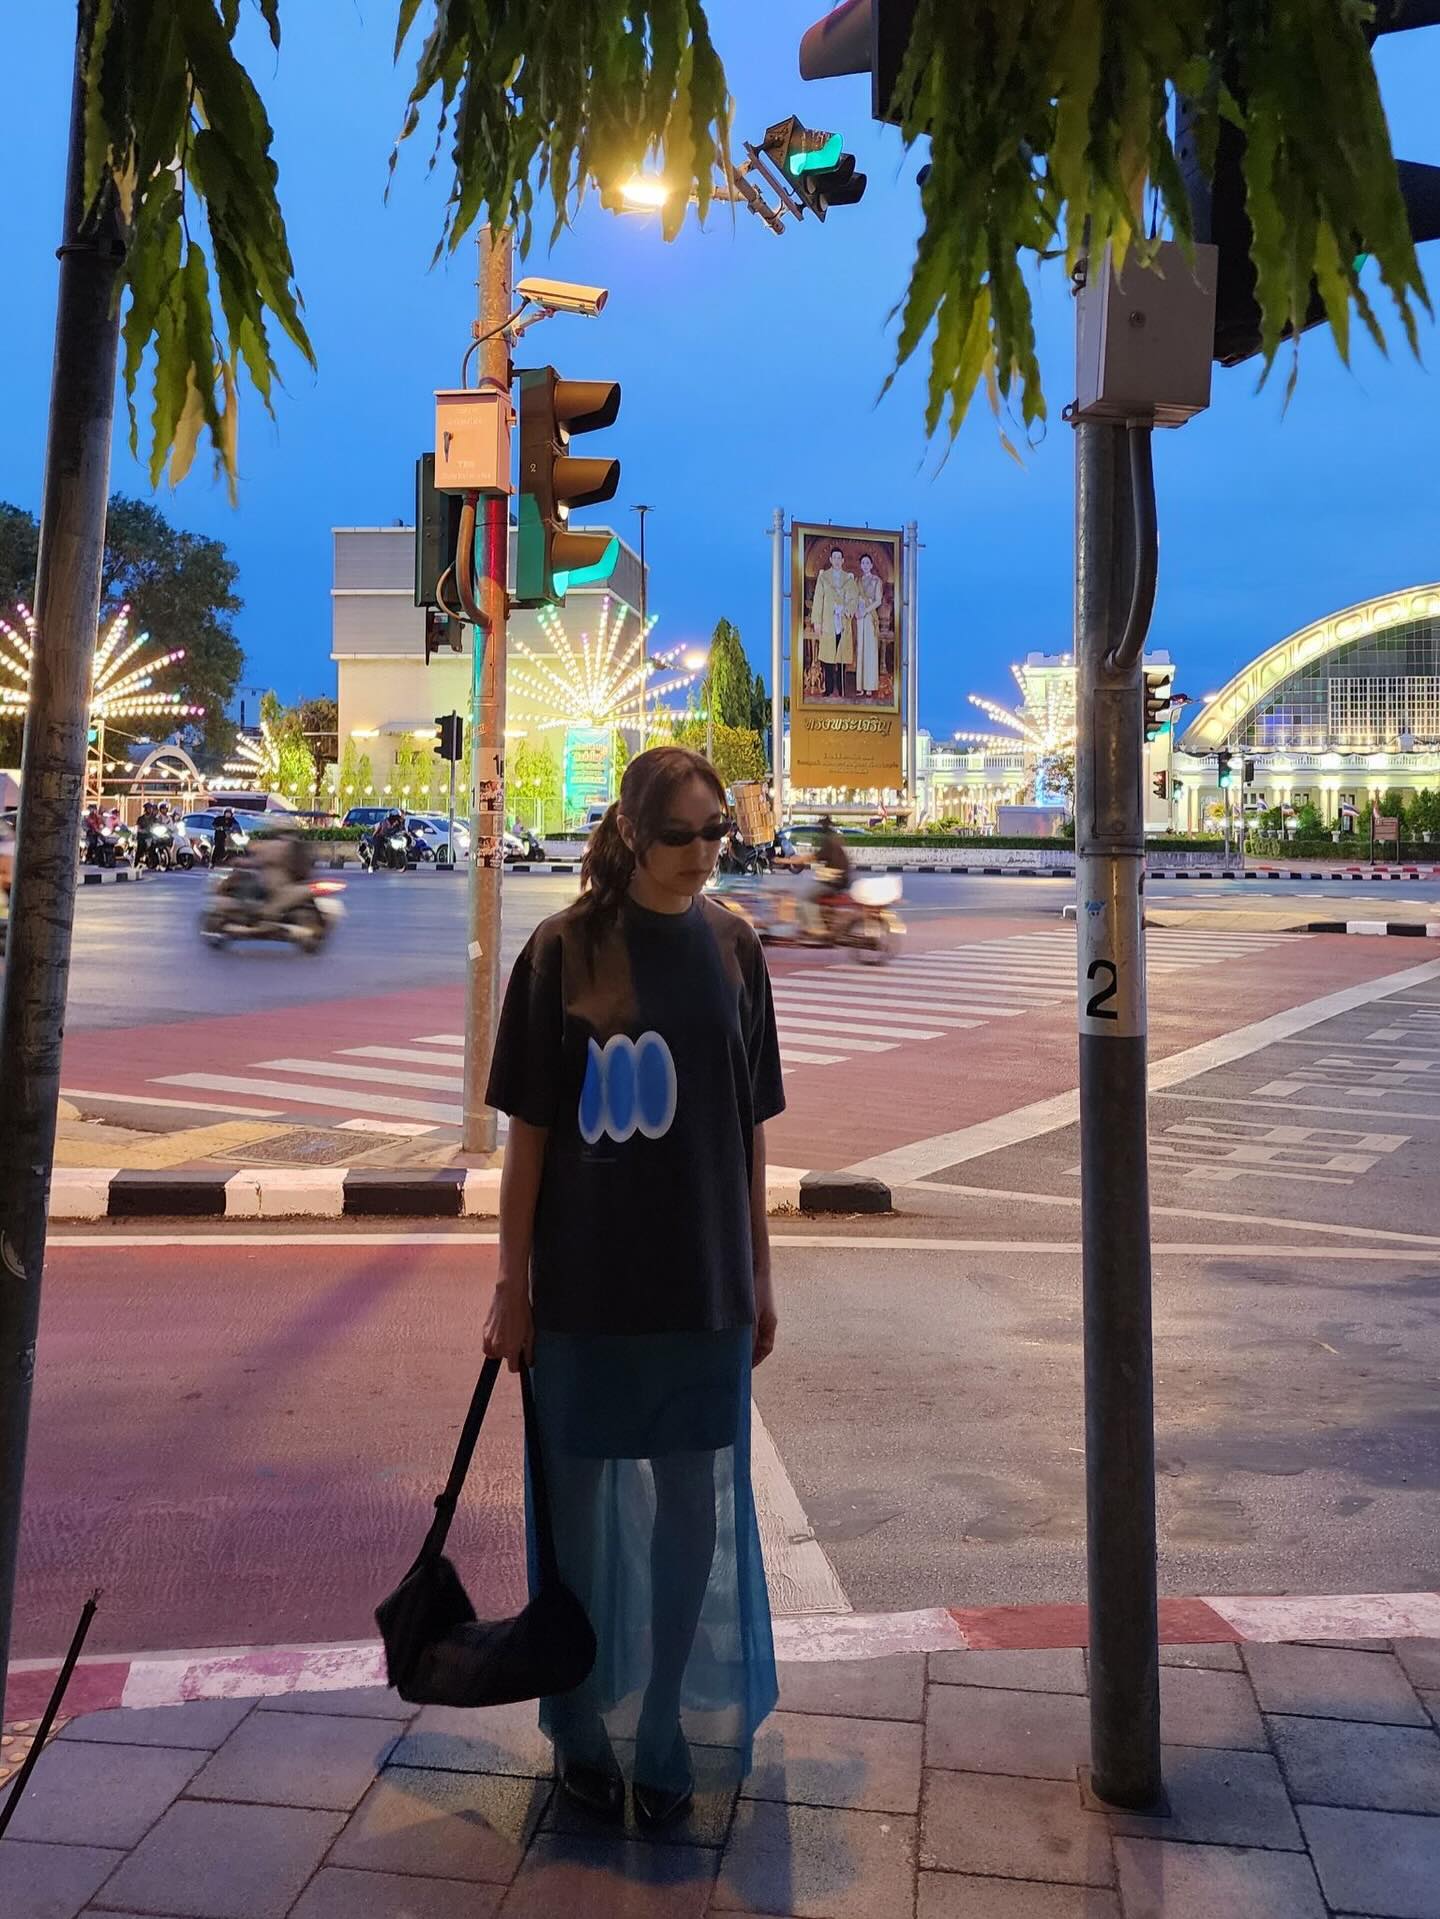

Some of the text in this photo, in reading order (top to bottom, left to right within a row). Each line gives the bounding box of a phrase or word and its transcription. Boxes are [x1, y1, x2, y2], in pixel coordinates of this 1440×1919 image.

[805, 715, 892, 737] ทรงพระเจริญ
[1086, 959, 1118, 1020] 2
